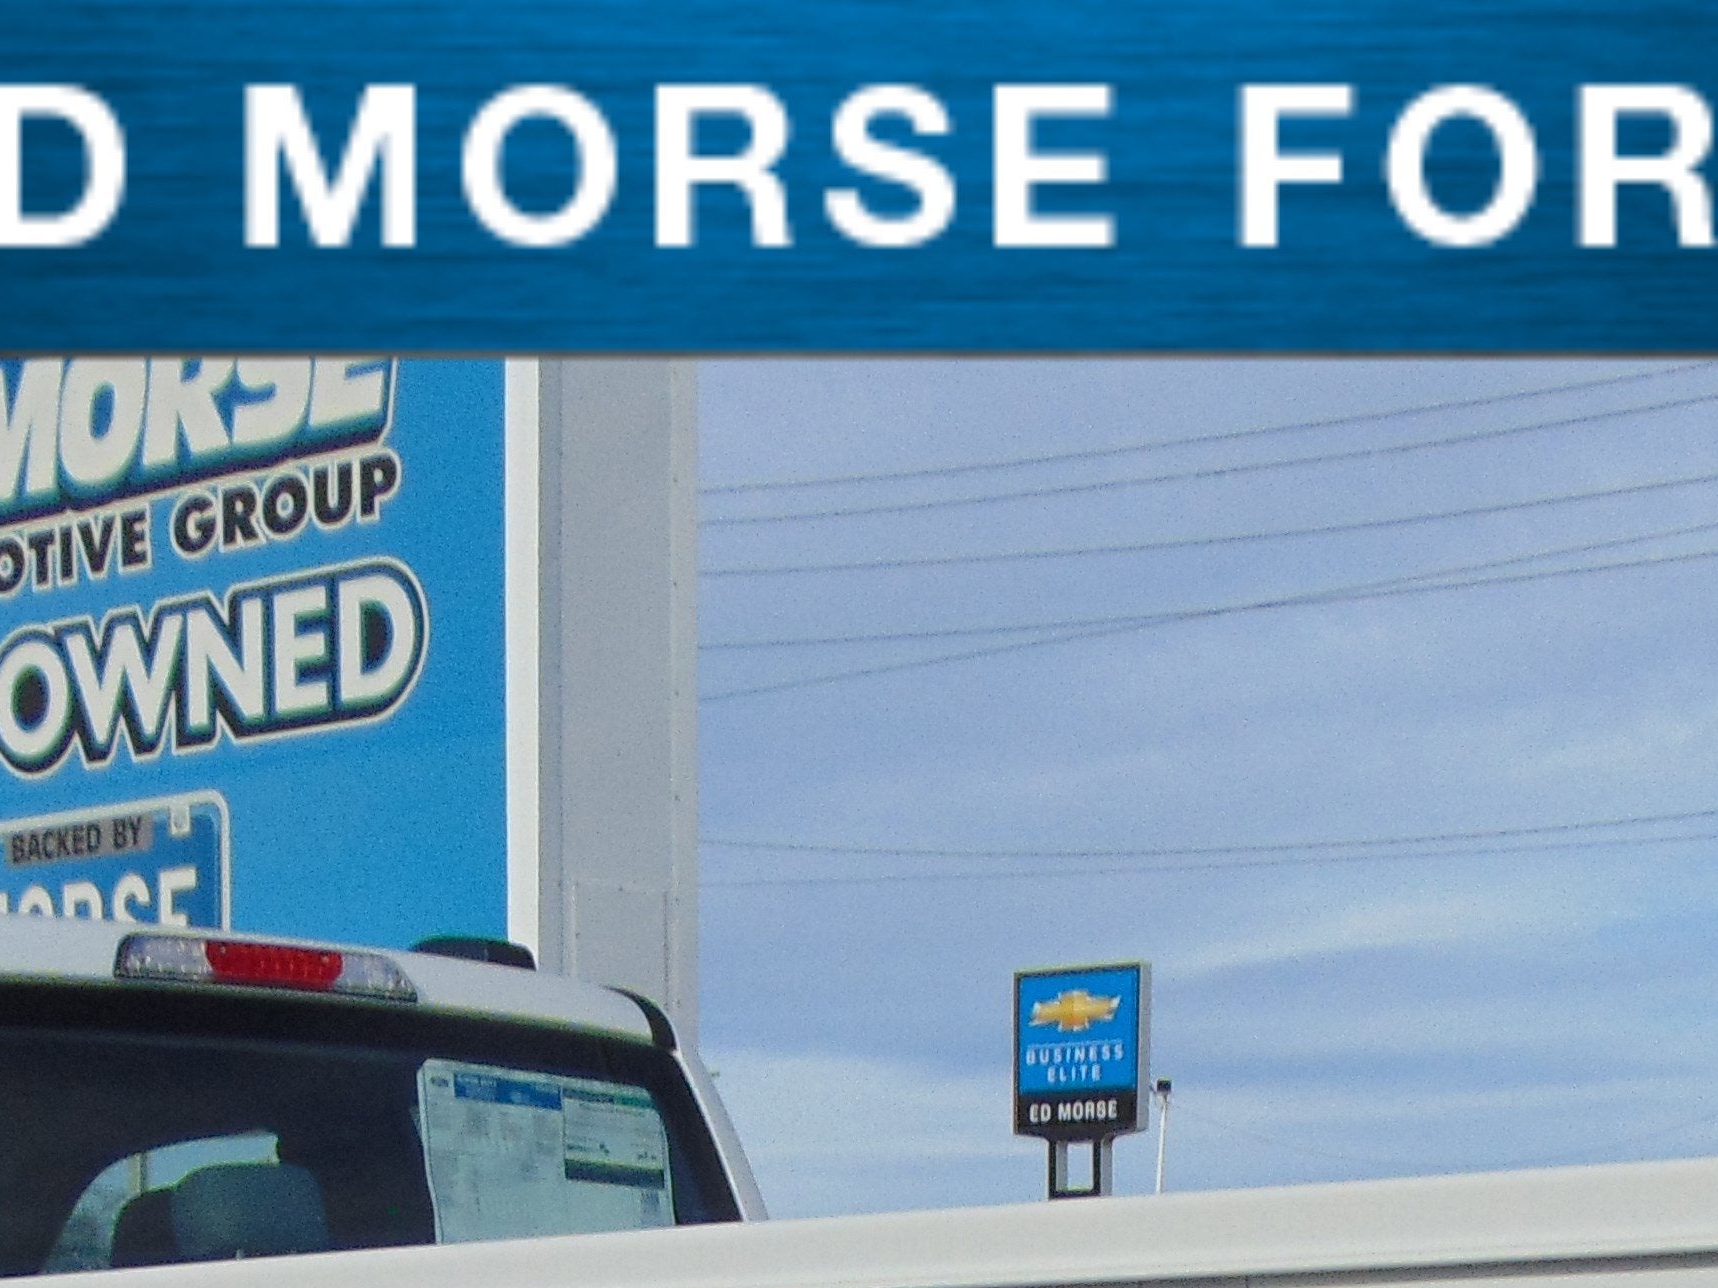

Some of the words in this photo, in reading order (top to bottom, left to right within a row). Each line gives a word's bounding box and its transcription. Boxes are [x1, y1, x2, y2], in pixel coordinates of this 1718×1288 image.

[172, 454, 399, 553] GROUP
[11, 822, 102, 865] BACKED
[112, 815, 143, 850] BY
[1025, 1042, 1123, 1066] BUSINESS
[1047, 1063, 1101, 1083] ELITE
[1029, 1102, 1052, 1123] ED
[1057, 1099, 1119, 1122] MORSE
